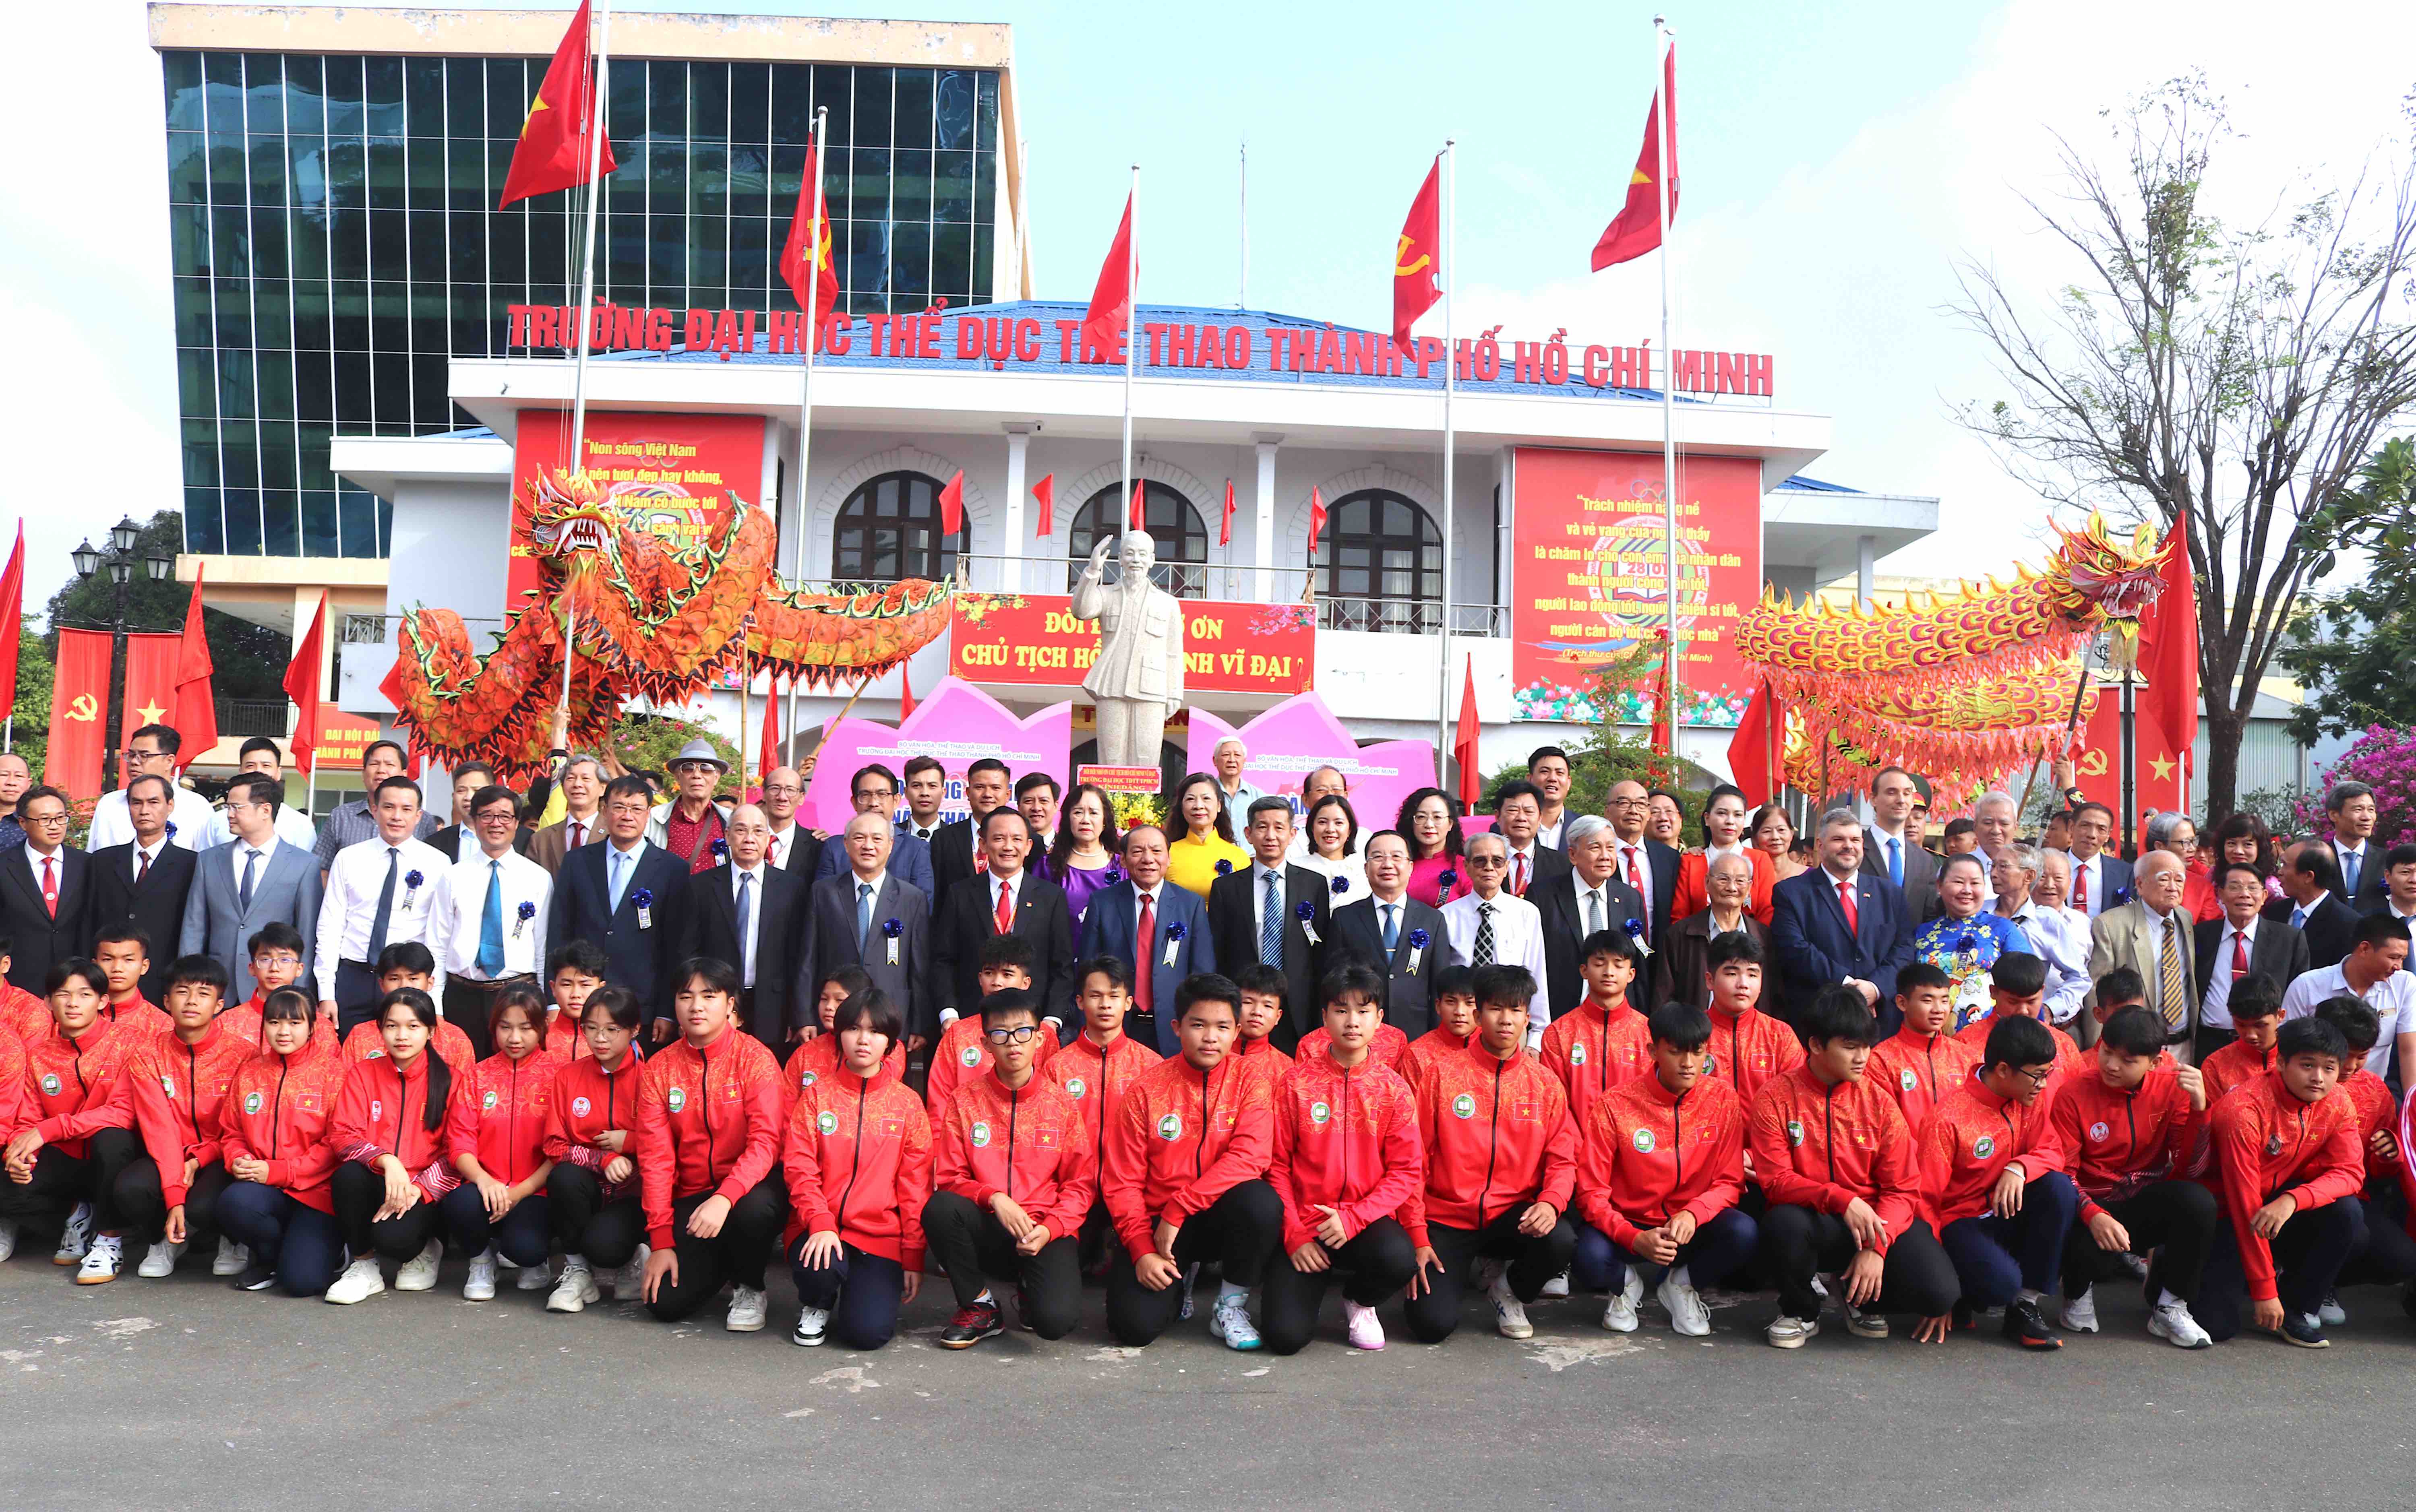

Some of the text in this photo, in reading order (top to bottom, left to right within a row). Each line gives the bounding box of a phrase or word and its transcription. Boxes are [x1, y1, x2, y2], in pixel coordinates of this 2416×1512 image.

[508, 296, 672, 351] TRƯỜNG
[685, 308, 755, 361] ĐẠI
[867, 297, 948, 358] THỂ
[957, 317, 1041, 370] DỤC
[1145, 323, 1251, 369] THAO
[1266, 322, 1403, 376] THÀNH
[1417, 325, 1504, 381] PHỐ
[1514, 328, 1568, 385] HỒ
[1584, 339, 1650, 389] CHÍ
[1672, 349, 1773, 396] MINH
[615, 442, 642, 457] sông
[645, 443, 667, 459] Việt
[669, 443, 696, 457] Nam
[589, 467, 610, 481] nên
[613, 468, 635, 481] tươi
[637, 469, 658, 486] đẹp
[660, 469, 681, 484] hay
[684, 470, 723, 485] không,
[625, 495, 652, 508] Nam
[654, 495, 670, 509] có
[672, 496, 699, 509] bước
[702, 496, 718, 509] tới
[1617, 500, 1652, 515] nhiệm
[1686, 500, 1700, 516] nề
[683, 523, 700, 535] vai
[1566, 522, 1580, 535] và
[1582, 521, 1596, 535] vẻ
[1599, 526, 1626, 539] vang
[1628, 523, 1650, 538] của
[1686, 525, 1710, 542] thầy
[1535, 545, 1546, 559] là
[1549, 547, 1580, 560] chăm
[1584, 547, 1595, 561] lo
[1597, 549, 1618, 562] cho
[1621, 552, 1642, 563] con
[1645, 552, 1663, 564] em
[1690, 553, 1717, 566] nhân
[1720, 554, 1741, 567] dân
[1628, 562, 1646, 574] 28
[1567, 572, 1599, 587] thành
[1602, 574, 1634, 589] người
[1636, 576, 1665, 591] công
[1690, 577, 1709, 592] tốt,
[1535, 597, 1567, 611] người
[1570, 598, 1587, 611] lao
[1590, 598, 1618, 615] động
[1621, 599, 1639, 615] tốt,
[1676, 601, 1707, 616] chiến
[1710, 603, 1720, 617] sĩ
[1722, 603, 1740, 618] tốt,
[1191, 615, 1224, 639] ƠN
[1550, 623, 1582, 638] người
[1585, 624, 1606, 638] cán
[1609, 625, 1623, 641] bộ
[1625, 624, 1640, 639] tốt
[962, 636, 1009, 666] CHỦ
[1014, 645, 1067, 673] TỊCH
[1220, 648, 1245, 675] VĨ
[1249, 655, 1291, 683] ĐẠI
[1689, 653, 1713, 663] Minh)
[325, 729, 342, 743] ĐẠI
[344, 728, 362, 743] HỘI
[343, 744, 363, 760] PHỐ
